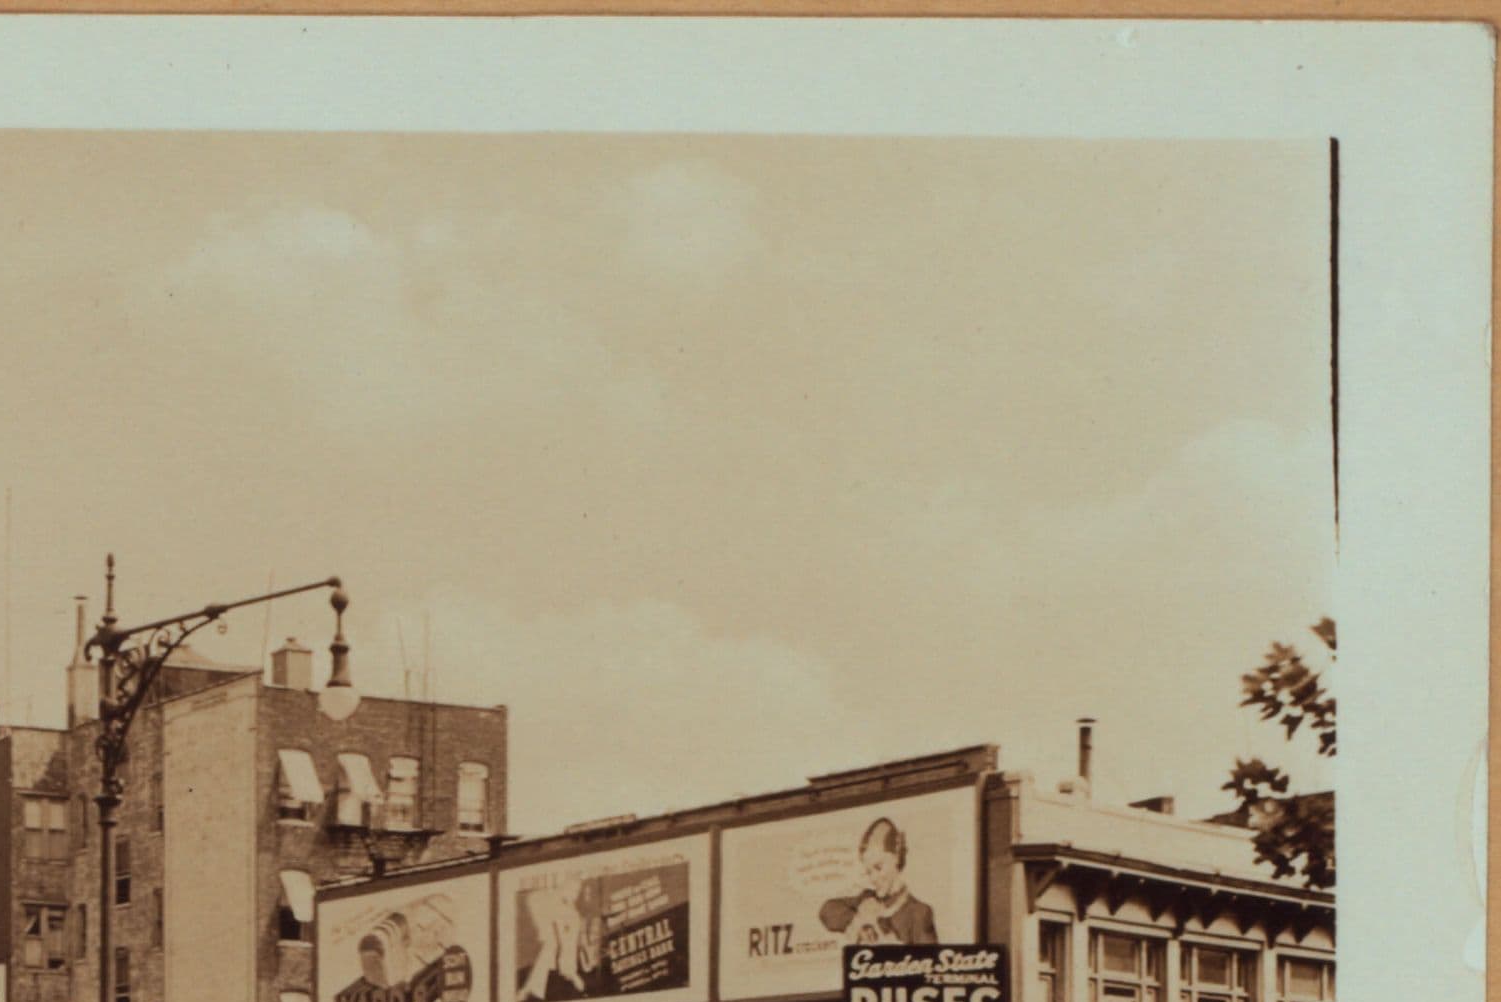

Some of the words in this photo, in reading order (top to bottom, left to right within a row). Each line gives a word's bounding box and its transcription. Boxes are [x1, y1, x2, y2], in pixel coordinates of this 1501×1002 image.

[609, 918, 674, 960] CENTRAL
[749, 924, 794, 957] RITZ
[849, 949, 934, 980] Garden
[934, 949, 999, 972] State
